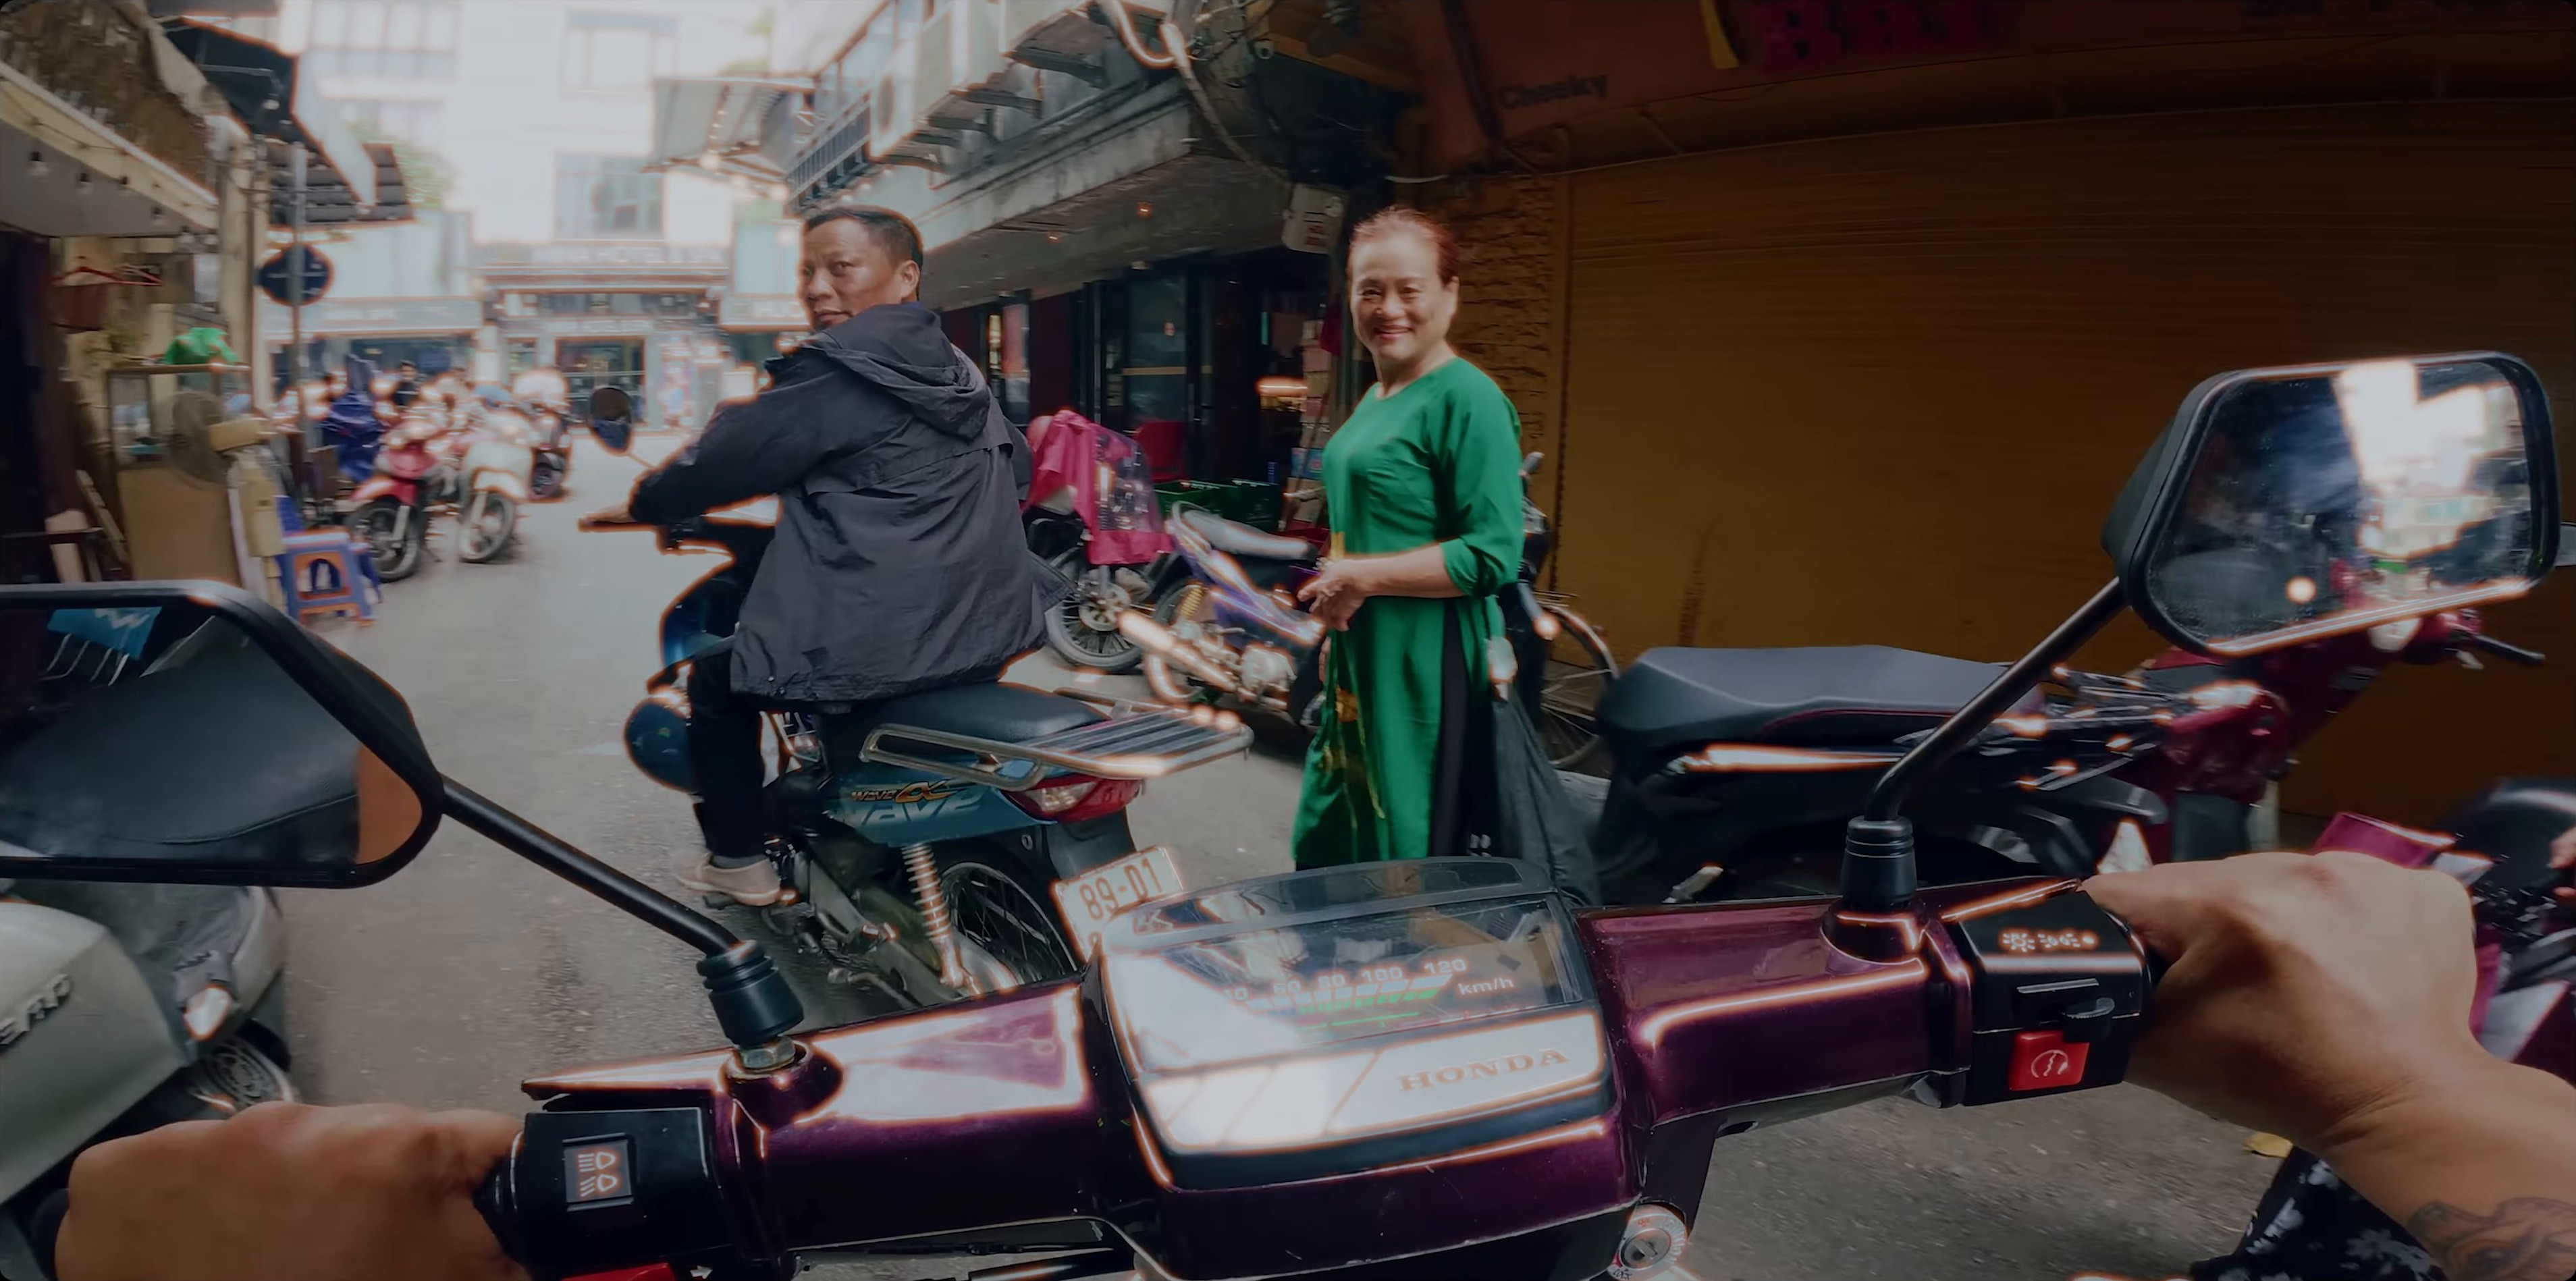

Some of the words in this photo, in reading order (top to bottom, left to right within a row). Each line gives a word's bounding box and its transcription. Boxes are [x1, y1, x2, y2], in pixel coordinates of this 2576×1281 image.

[1272, 980, 1302, 995] 60
[1318, 973, 1346, 989] 80
[1360, 966, 1403, 983] 100
[1424, 958, 1468, 975] 120
[1458, 977, 1514, 996] km/h
[1398, 1048, 1570, 1091] HONDA
